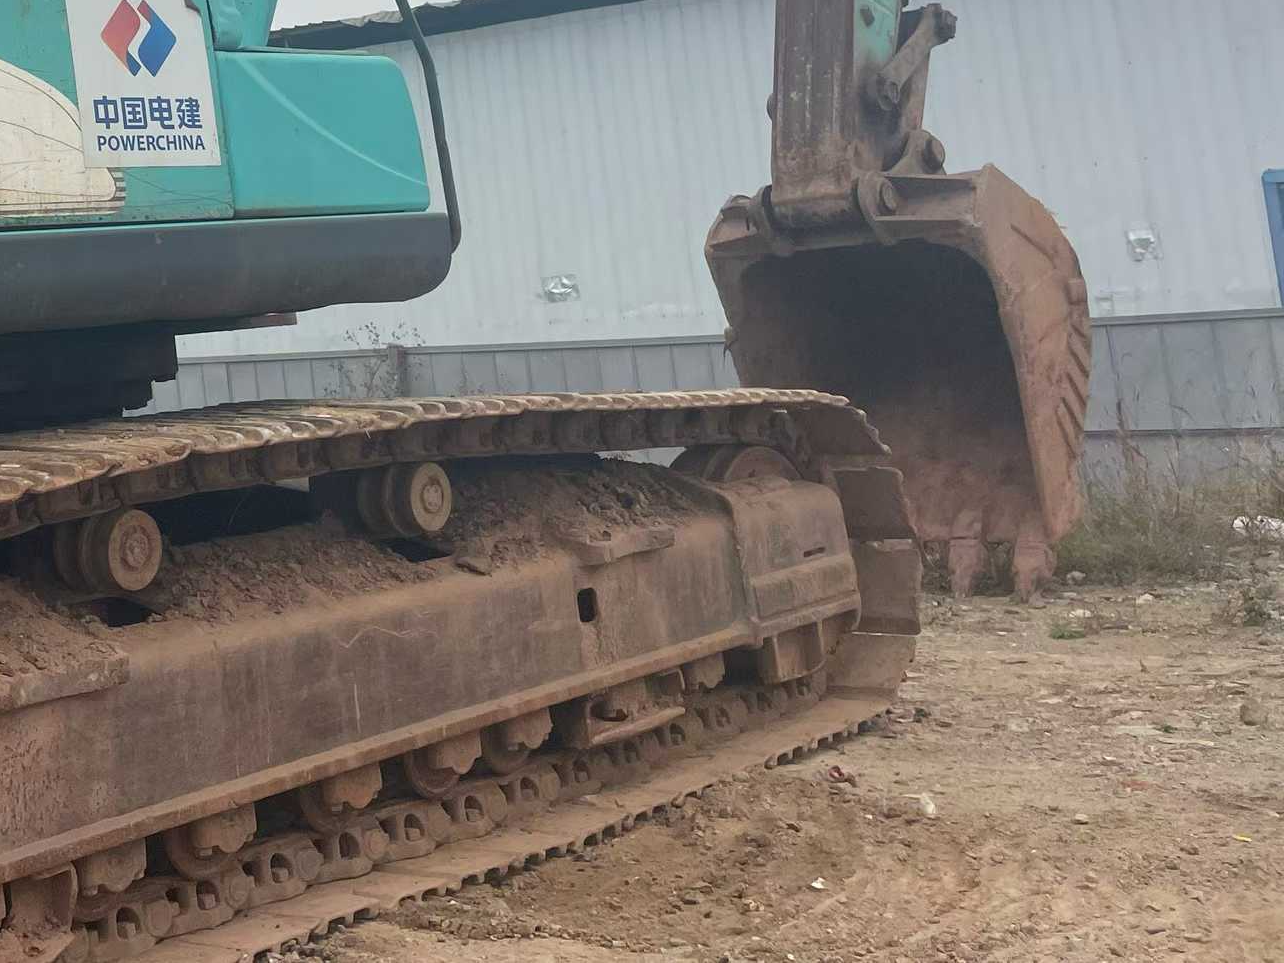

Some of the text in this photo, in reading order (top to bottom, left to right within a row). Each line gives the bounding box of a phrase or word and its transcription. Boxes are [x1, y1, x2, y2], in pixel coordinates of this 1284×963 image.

[93, 96, 203, 129] 中国电建
[97, 134, 206, 151] POWERCHINA
